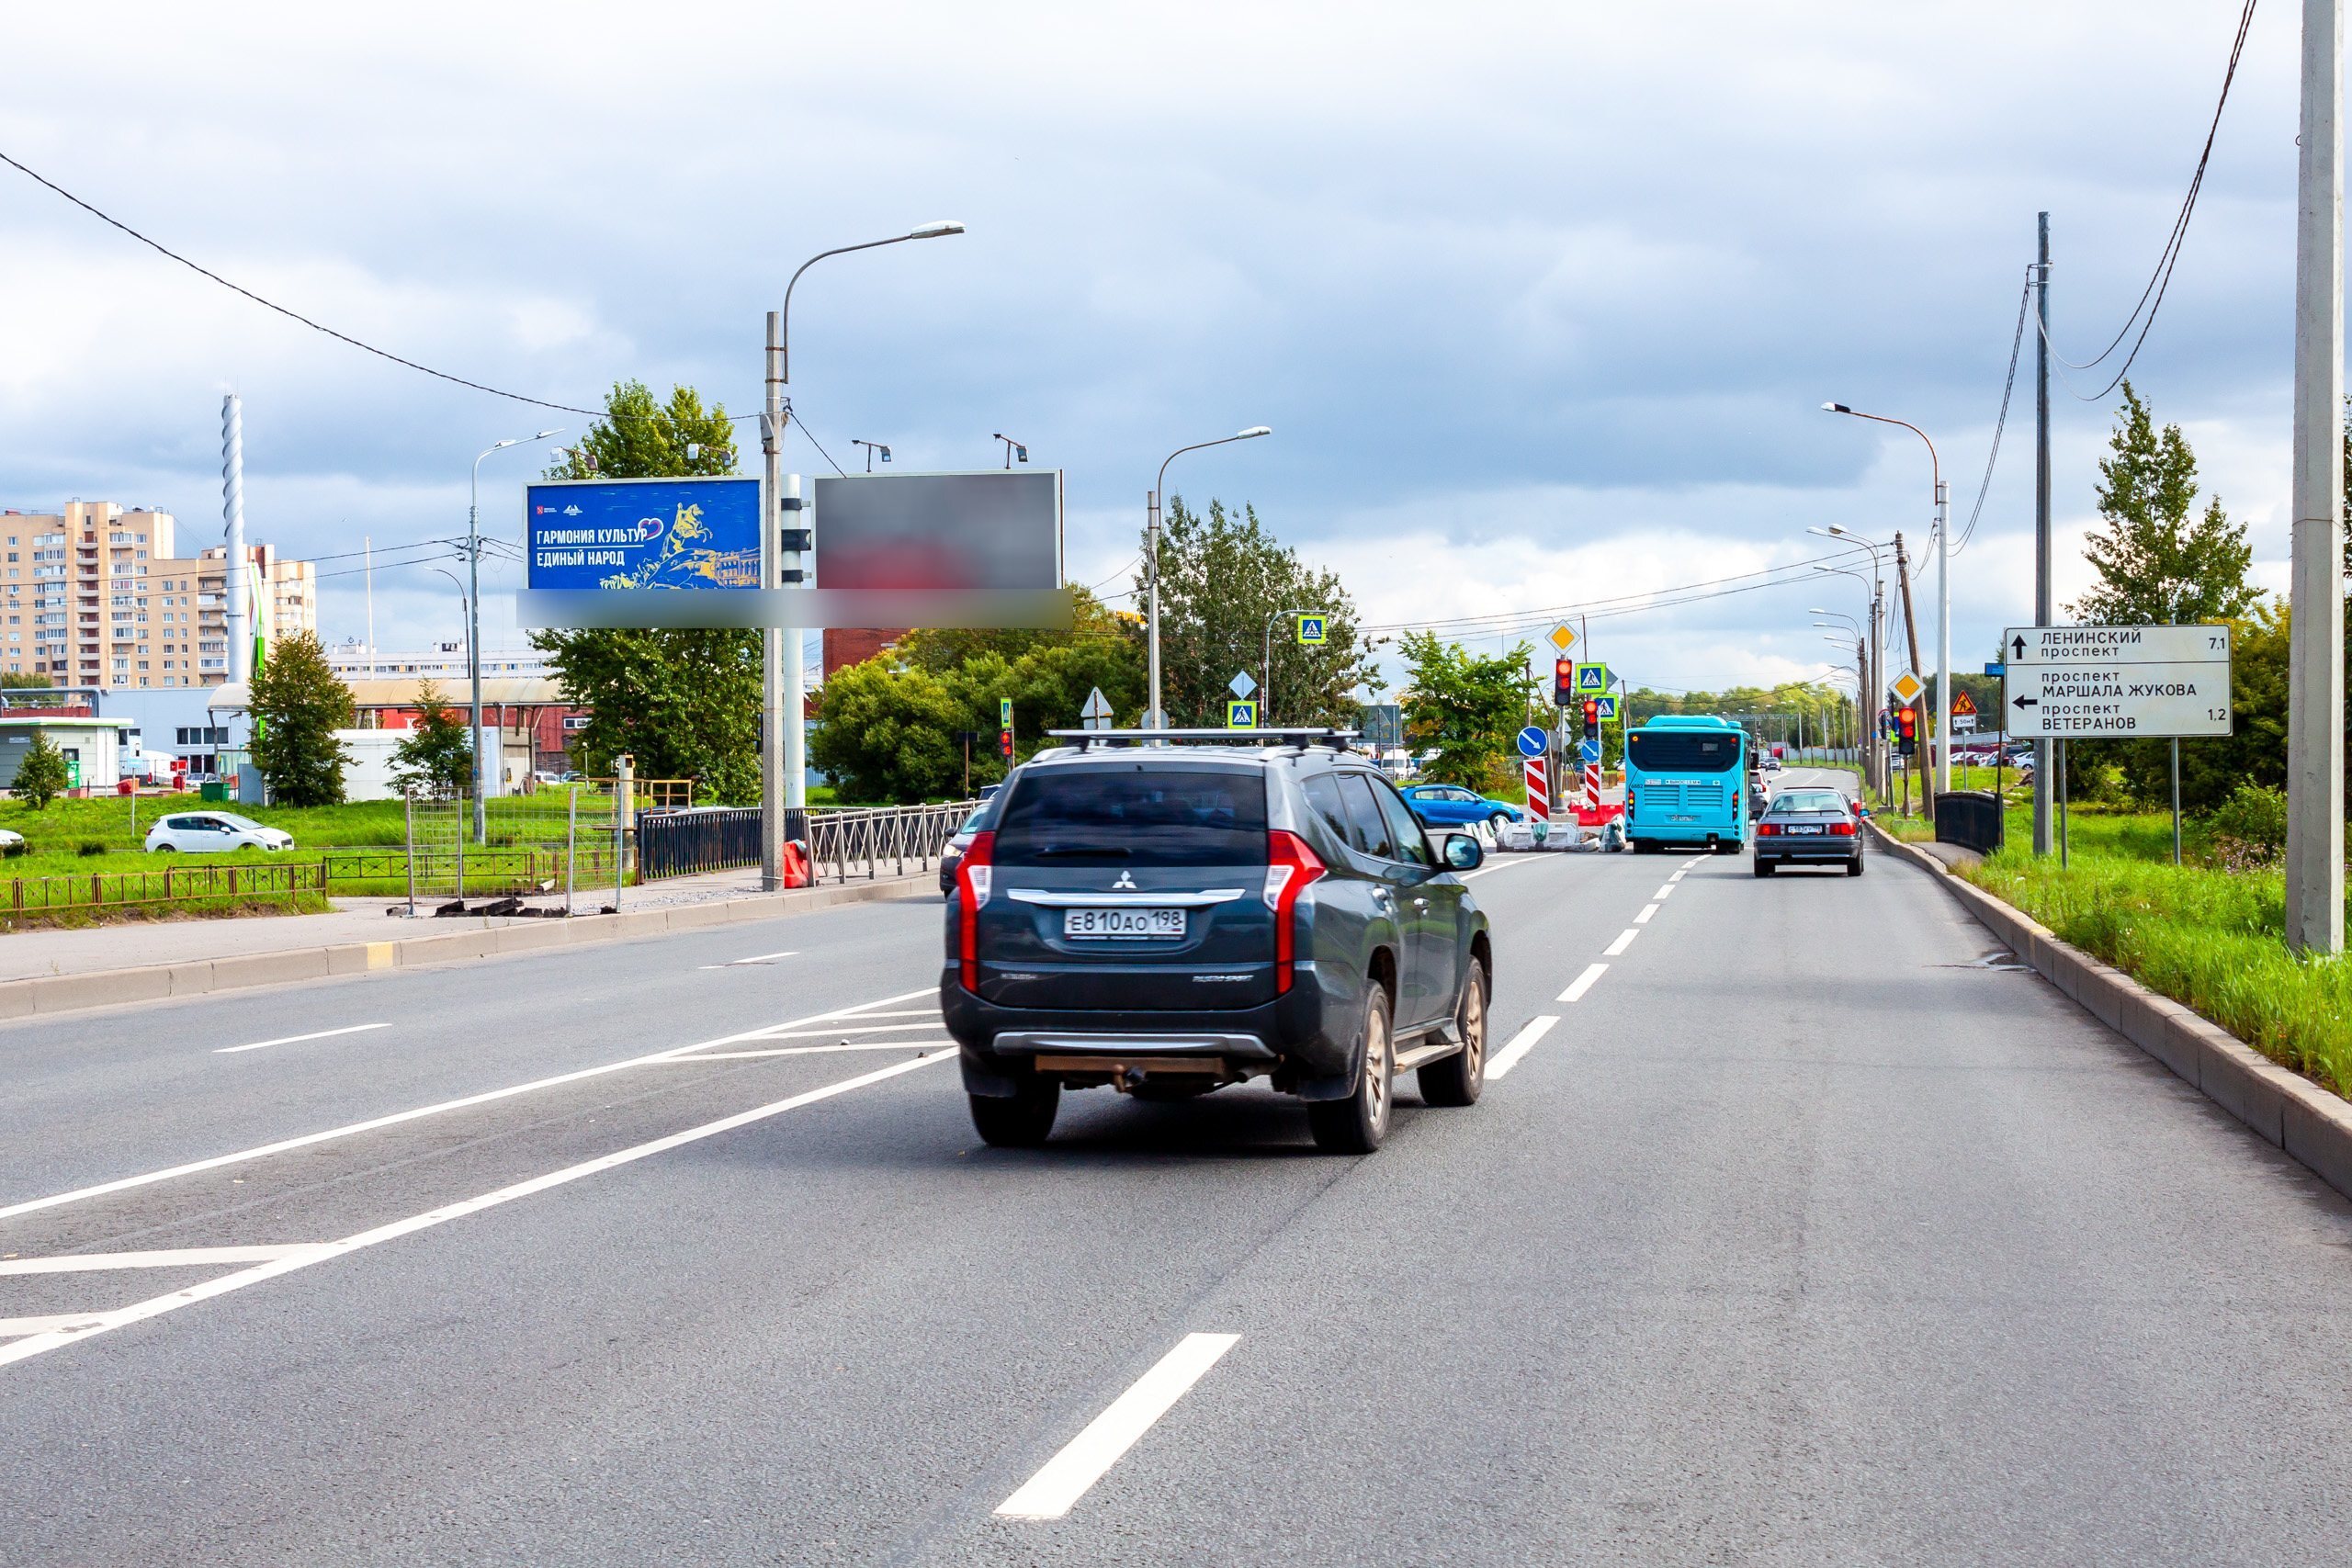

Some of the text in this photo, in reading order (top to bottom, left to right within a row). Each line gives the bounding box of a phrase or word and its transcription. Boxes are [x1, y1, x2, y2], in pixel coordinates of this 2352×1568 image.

[537, 527, 647, 545] ГАРМОНИЯ КУЛЬТУР
[537, 549, 625, 568] ЕДИНЫЙ НАРОД
[2041, 628, 2141, 645] ЛЕНИНСКИЙ
[2209, 637, 2225, 650] 7,1
[2041, 647, 2119, 660] проспект
[2041, 671, 2120, 684] проспект
[2042, 683, 2197, 697] МАРШАЛА ЖУКОВА
[2042, 704, 2120, 717] проспект
[2208, 709, 2226, 721] 1,2
[2042, 717, 2136, 730] ВЕТЕРАНОВ
[1151, 911, 1180, 926] 198
